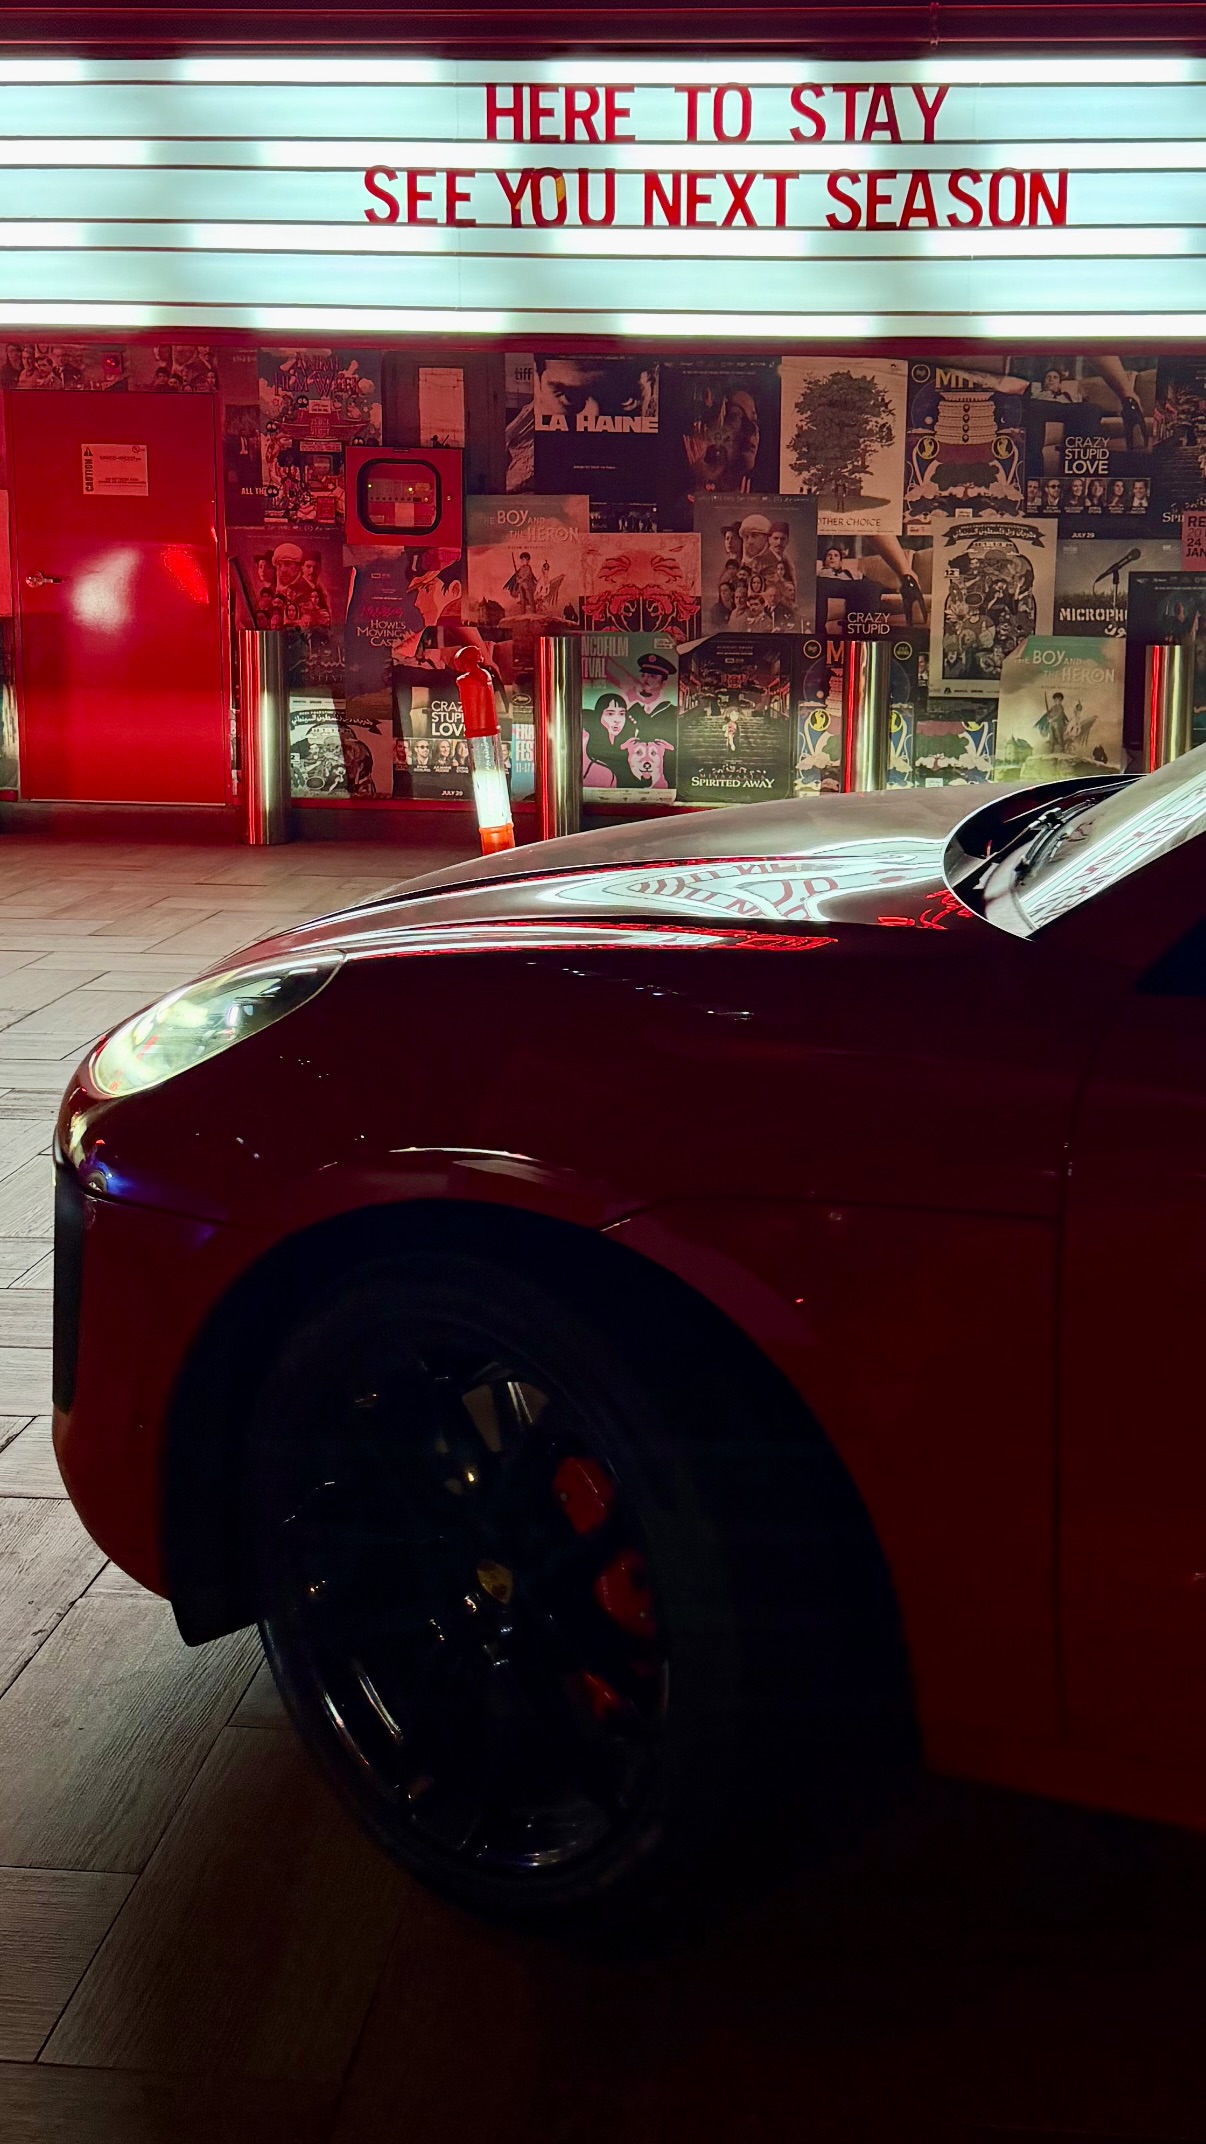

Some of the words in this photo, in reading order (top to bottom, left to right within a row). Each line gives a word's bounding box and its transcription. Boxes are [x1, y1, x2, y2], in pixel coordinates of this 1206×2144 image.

[485, 83, 637, 143] HERE
[675, 83, 752, 143] TO
[790, 82, 950, 144] STAY
[364, 166, 476, 226] SEE
[495, 167, 616, 228] YOU
[644, 169, 800, 228] NEXT
[826, 167, 1068, 230] SEASON
[534, 414, 569, 432] LA
[575, 415, 660, 434] HAINE
[1065, 436, 1111, 448] CRAZY
[1064, 448, 1110, 460] STUPID
[1064, 460, 1109, 474] LOVE
[84, 459, 94, 492] CAUTION
[497, 510, 529, 527] BOY
[846, 518, 881, 527] CHOICE
[527, 527, 579, 542] HERON
[1187, 538, 1201, 547] 24
[847, 612, 891, 623] CRAZY
[356, 626, 404, 638] MOVING
[847, 623, 891, 635] STUPID
[1032, 650, 1065, 667] BOY
[1062, 668, 1115, 683] HERON
[691, 776, 741, 787] SPIRITED
[742, 778, 775, 788] AWAY
